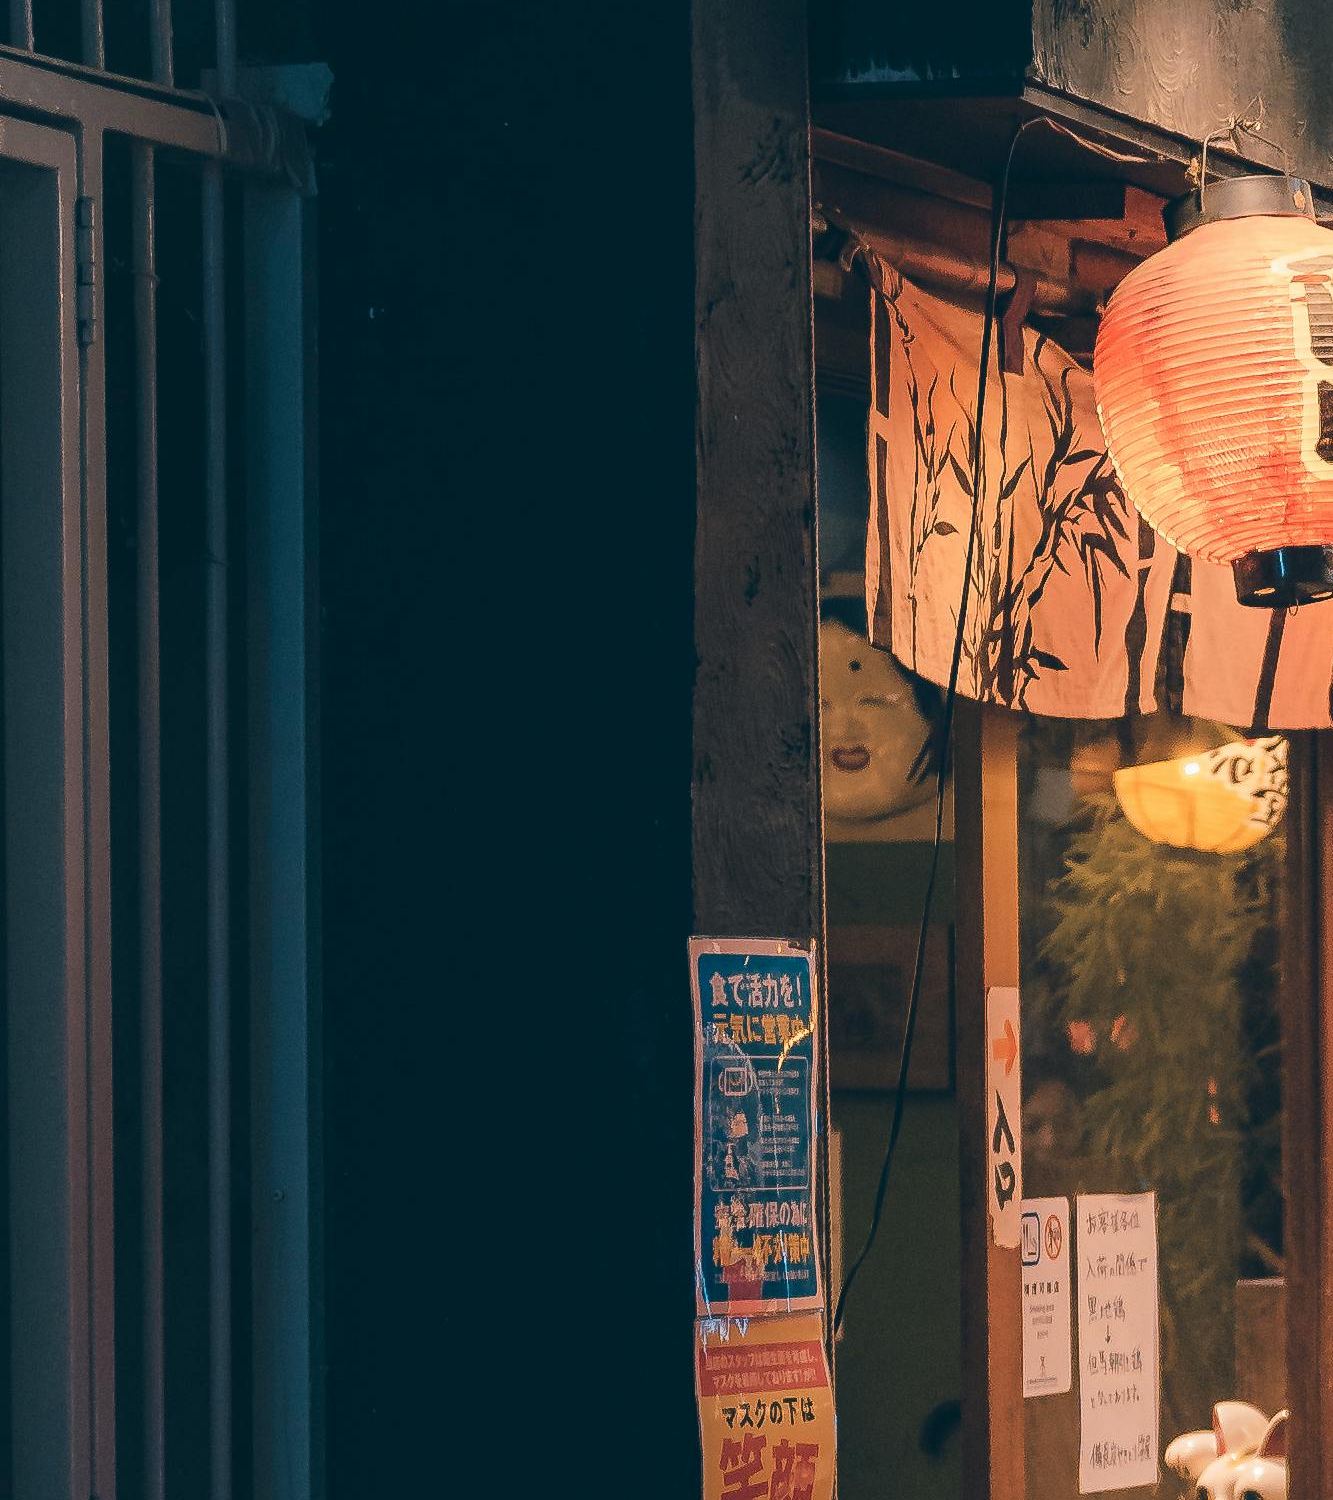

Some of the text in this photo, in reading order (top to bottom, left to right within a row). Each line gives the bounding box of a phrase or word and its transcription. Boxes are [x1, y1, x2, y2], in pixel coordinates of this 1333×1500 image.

[992, 1090, 1017, 1213] 入口
[721, 1396, 816, 1429] マスクの下は
